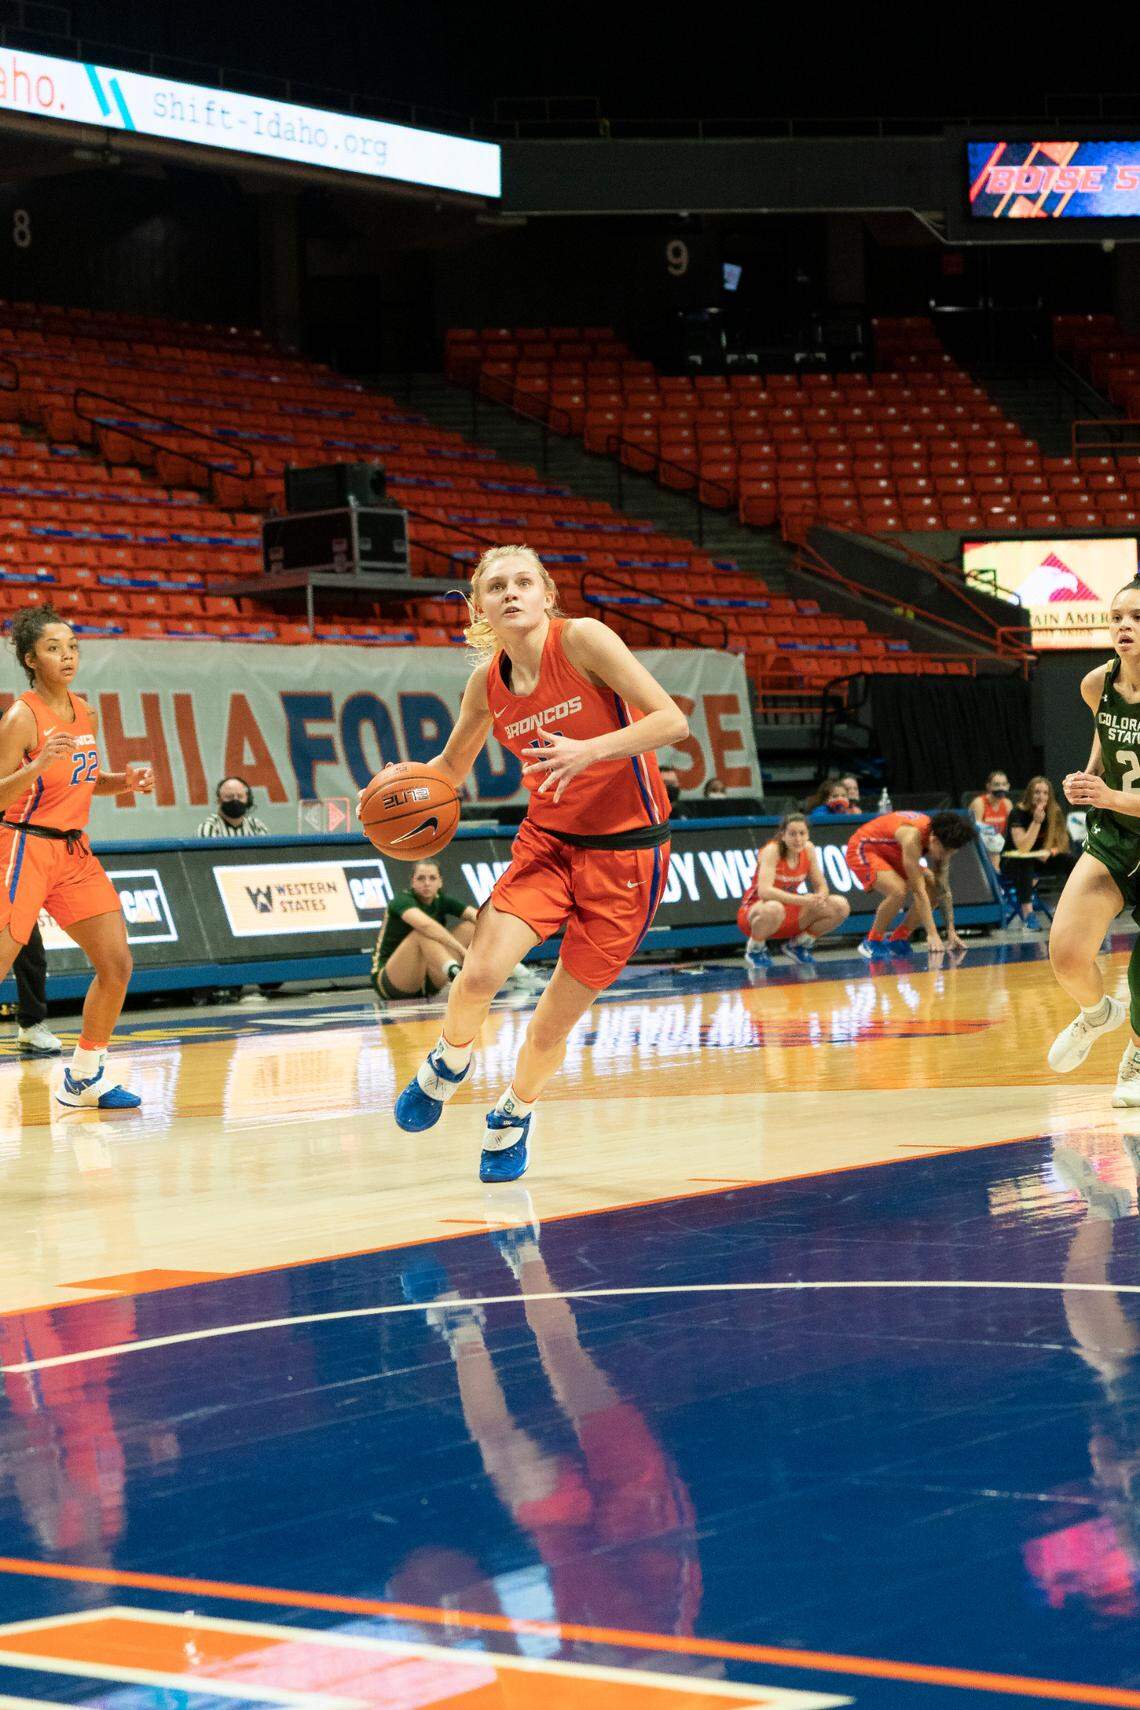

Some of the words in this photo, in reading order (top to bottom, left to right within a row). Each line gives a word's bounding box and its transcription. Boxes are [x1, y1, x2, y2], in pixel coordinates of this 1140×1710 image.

[153, 92, 388, 166] Shift-Idaho.org
[985, 165, 1107, 194] BOISE
[13, 208, 31, 249] 8
[666, 239, 689, 276] 9
[504, 695, 582, 739] BRONCOS
[75, 691, 289, 808] HIA
[69, 751, 99, 786] 22
[1116, 750, 1140, 794] 2
[119, 889, 163, 924] CAT
[275, 881, 338, 896] WESTERN
[279, 899, 327, 913] STATES
[349, 877, 388, 909] CAT
